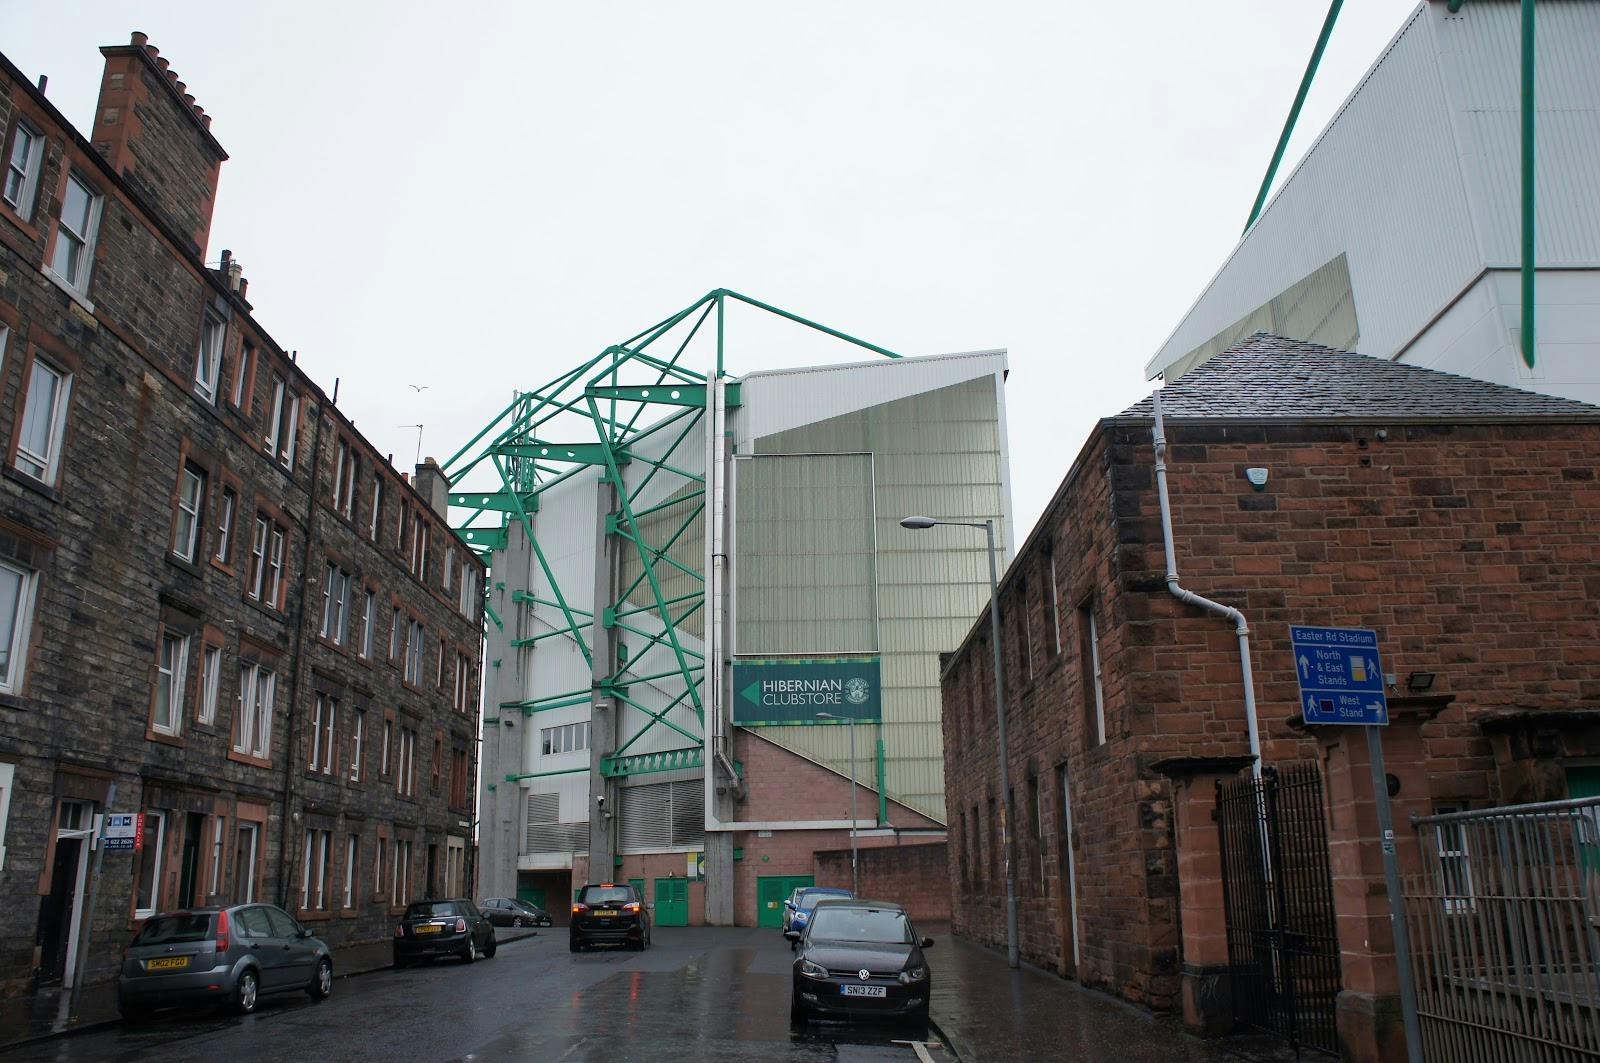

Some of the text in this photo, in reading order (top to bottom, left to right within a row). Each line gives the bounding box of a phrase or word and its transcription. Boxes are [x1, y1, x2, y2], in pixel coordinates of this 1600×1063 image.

[1296, 630, 1373, 643] Easter Rd Stadium
[1316, 649, 1341, 660] North
[1317, 662, 1344, 673] & East
[763, 679, 842, 692] HIBERNIAN
[1318, 675, 1347, 686] Stands
[763, 692, 842, 706] CLUBSTORE
[1339, 695, 1361, 705] West
[1340, 708, 1364, 718] Stand
[847, 986, 883, 996] SN13 ZZF
